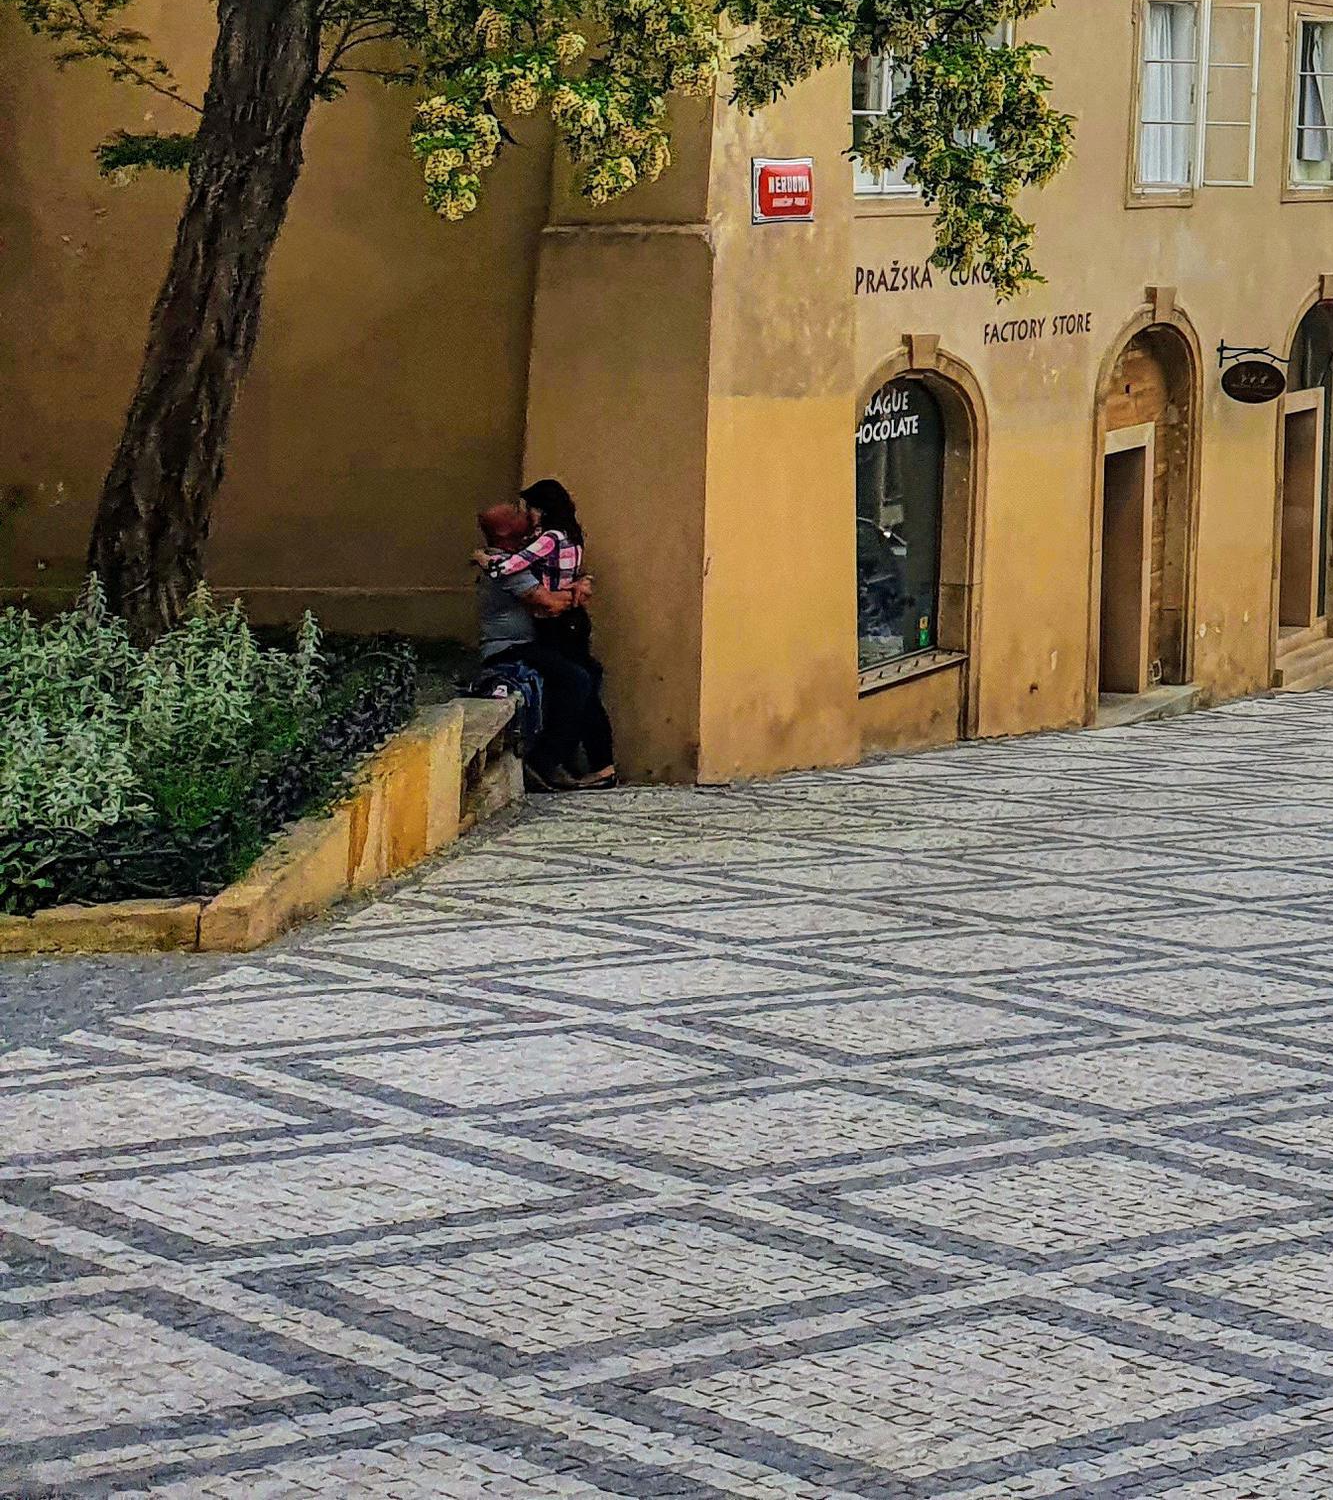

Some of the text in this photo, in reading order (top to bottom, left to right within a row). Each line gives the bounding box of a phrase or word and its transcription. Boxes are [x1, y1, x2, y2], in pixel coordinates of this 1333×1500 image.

[983, 312, 1092, 345] FACTORY STORE
[865, 389, 909, 416] RAGUE
[855, 415, 919, 444] HOCOLATE
